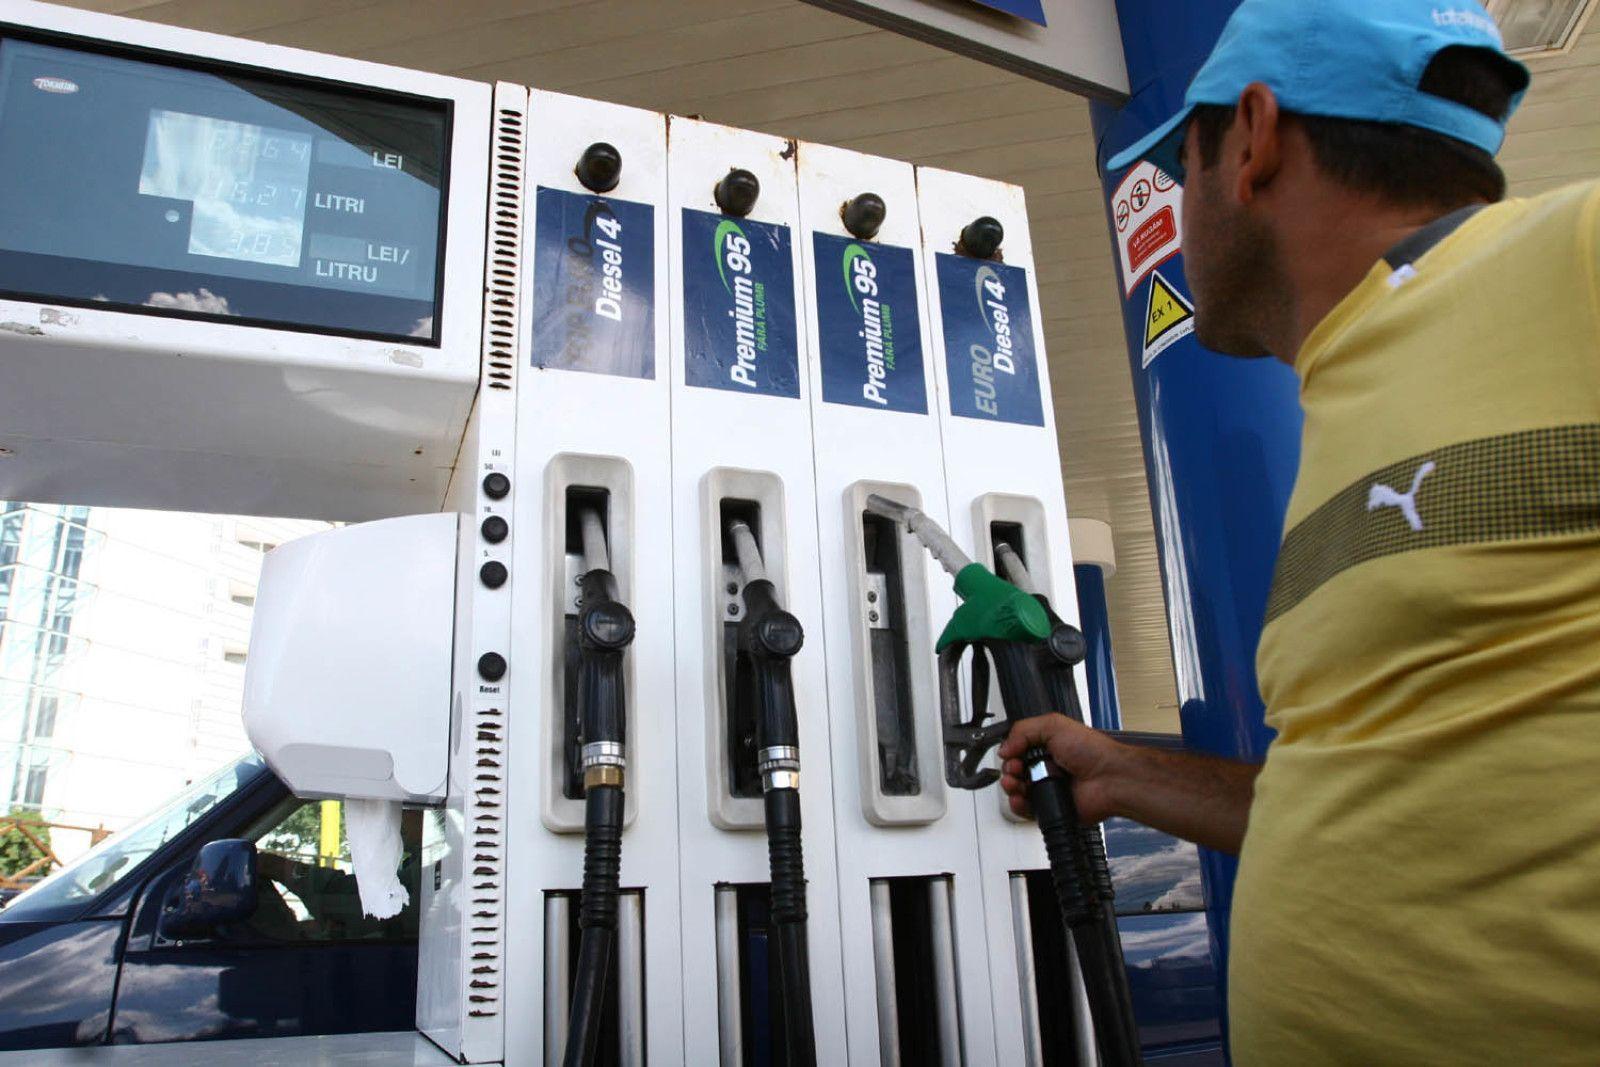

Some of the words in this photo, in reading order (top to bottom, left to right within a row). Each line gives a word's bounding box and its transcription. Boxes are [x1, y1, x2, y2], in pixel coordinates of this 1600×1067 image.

[373, 151, 403, 170] LEI
[315, 193, 364, 213] LITRI
[595, 216, 622, 237] 4
[726, 233, 752, 274] 95
[316, 260, 377, 282] LITRU
[595, 239, 622, 321] Diesel
[854, 256, 878, 297] 95
[984, 276, 1006, 297] 4
[753, 282, 767, 314] PLUMB
[1151, 306, 1165, 323] EX
[1166, 300, 1174, 311] 1
[728, 278, 757, 387] Premium
[881, 304, 894, 338] PLUMB
[987, 298, 1016, 376] Diesel
[858, 298, 888, 405] Premium
[970, 343, 997, 416] EURO
[480, 685, 499, 693] Reset
